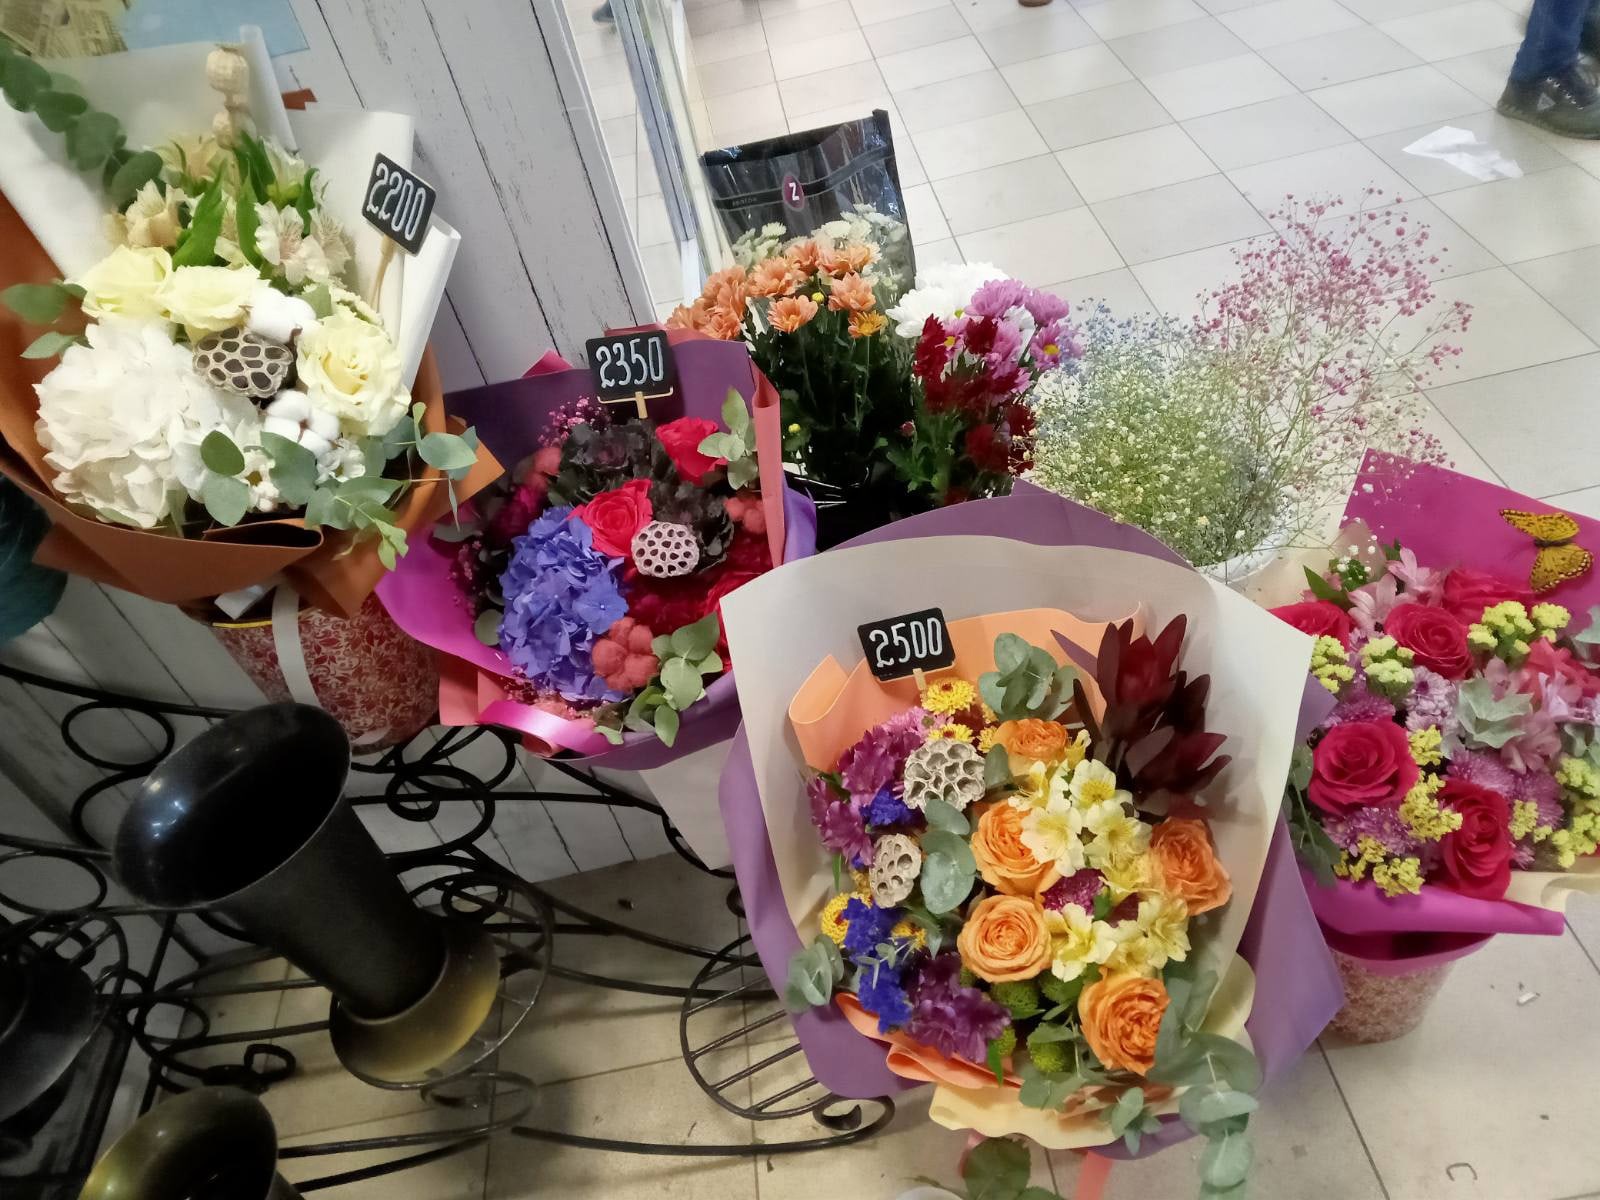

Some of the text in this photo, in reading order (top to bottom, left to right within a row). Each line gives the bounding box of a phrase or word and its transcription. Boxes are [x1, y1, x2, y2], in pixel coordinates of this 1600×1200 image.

[366, 162, 426, 241] 2200
[595, 336, 664, 389] 2350
[868, 617, 943, 668] 2500
